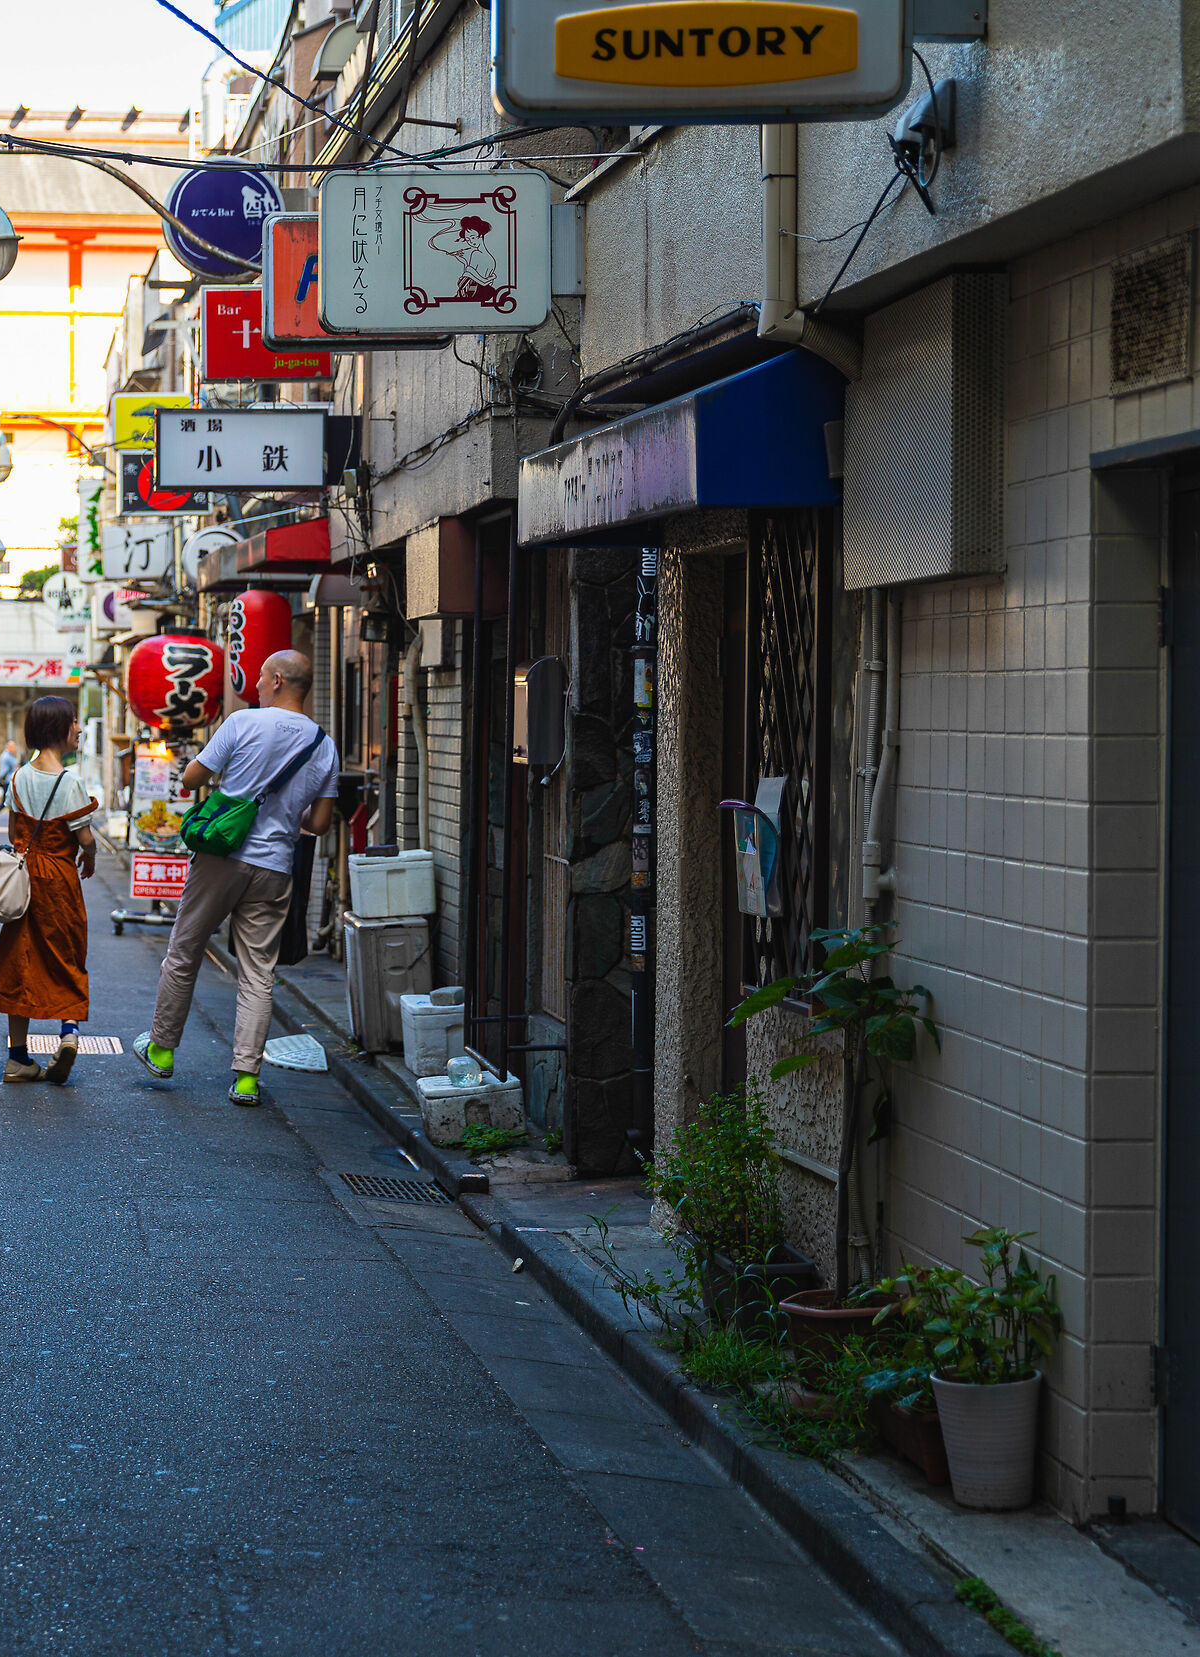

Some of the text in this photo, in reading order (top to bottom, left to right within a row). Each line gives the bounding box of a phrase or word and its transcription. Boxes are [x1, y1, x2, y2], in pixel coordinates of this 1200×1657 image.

[591, 25, 824, 61] SUNTORY
[352, 187, 369, 314] 月に吠える
[217, 304, 241, 315] Bar
[273, 357, 319, 369] ju-ga-tsu
[181, 418, 223, 432] 酒場
[197, 445, 289, 472] 小鉄
[136, 863, 186, 881] 営業中!
[135, 886, 156, 895] OPEN
